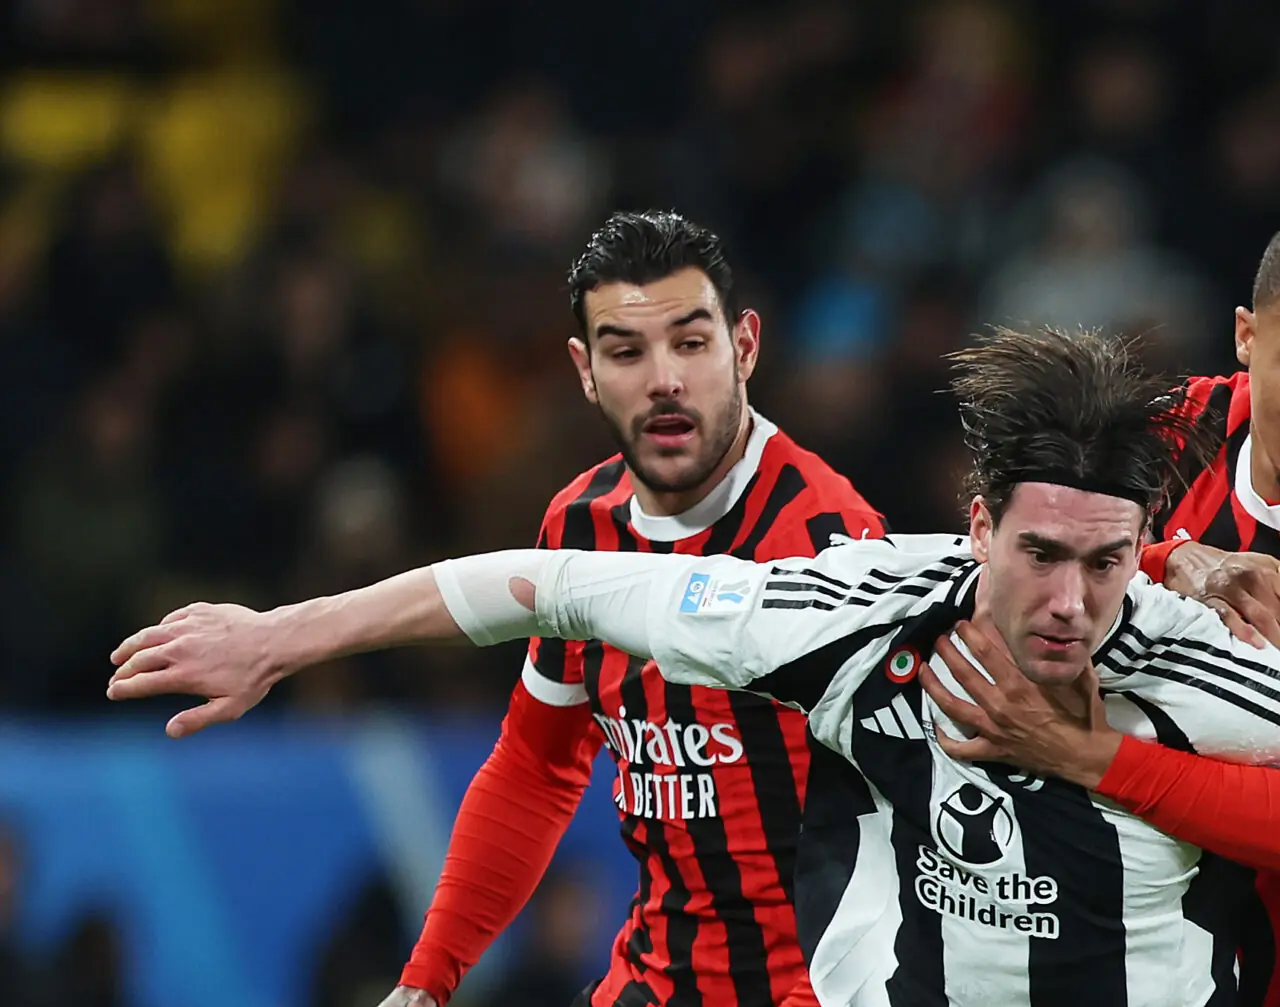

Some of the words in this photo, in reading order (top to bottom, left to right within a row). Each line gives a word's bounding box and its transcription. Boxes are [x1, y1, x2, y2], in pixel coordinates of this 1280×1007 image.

[630, 772, 717, 820] BETTER
[920, 848, 989, 894] Save
[996, 873, 1053, 900] the
[918, 878, 1055, 935] Children
